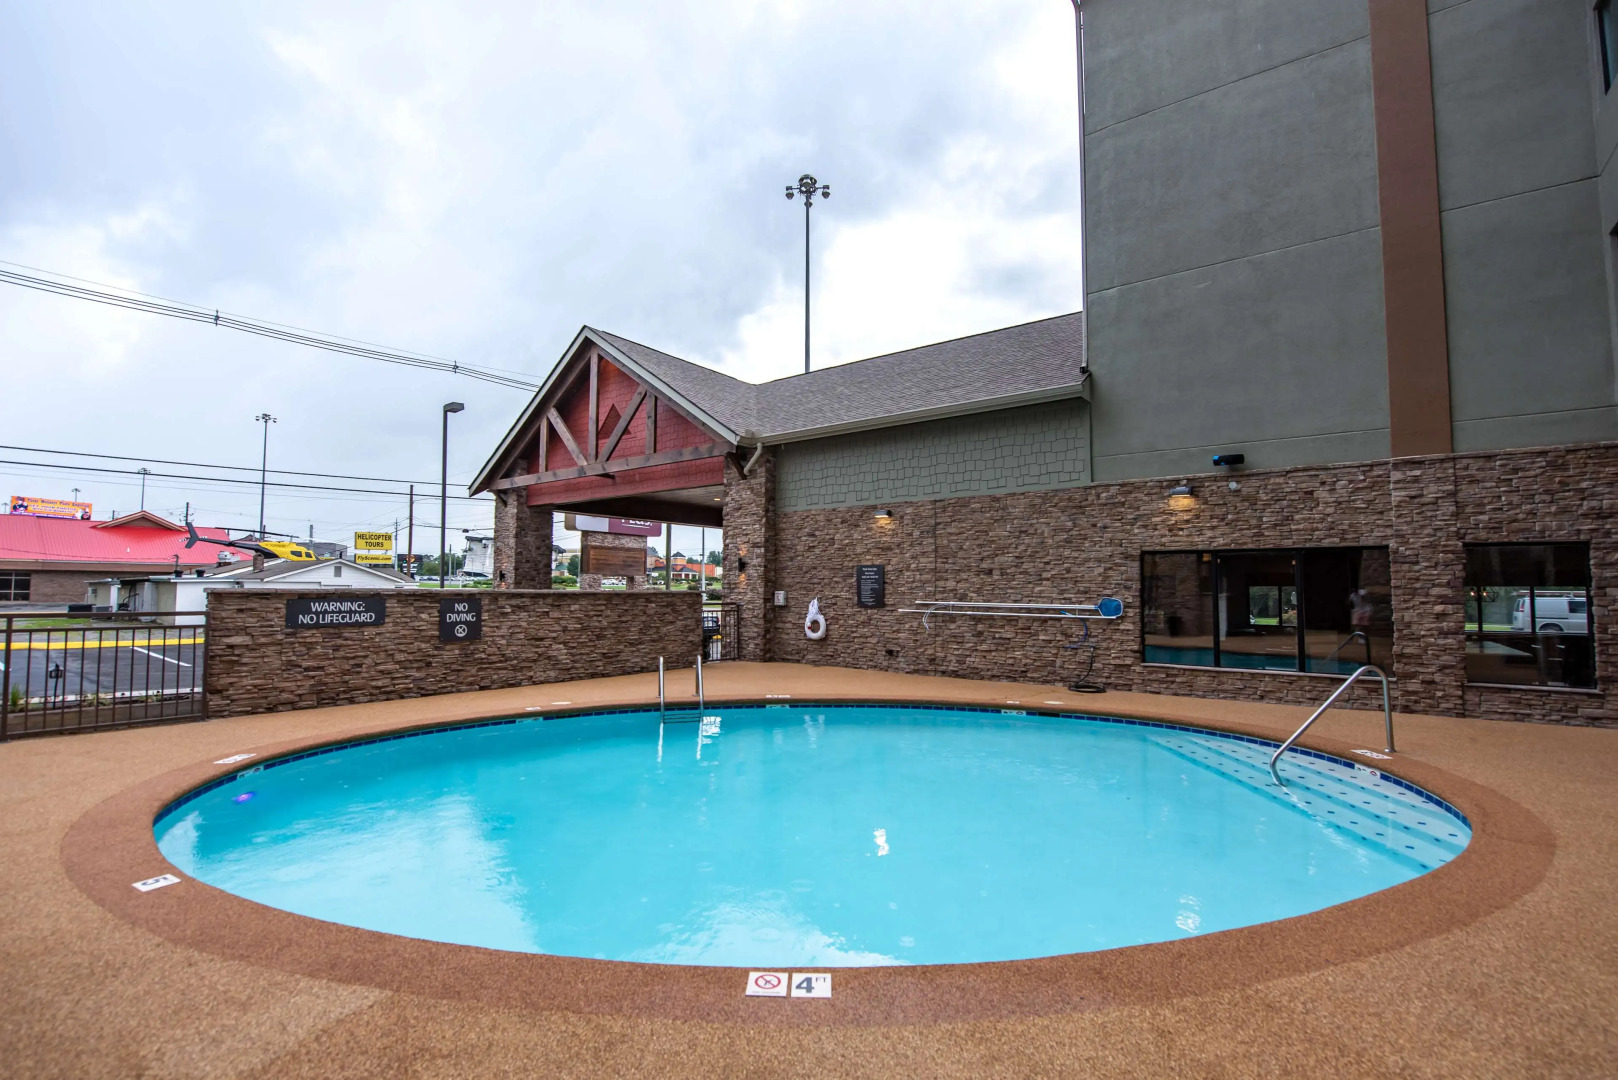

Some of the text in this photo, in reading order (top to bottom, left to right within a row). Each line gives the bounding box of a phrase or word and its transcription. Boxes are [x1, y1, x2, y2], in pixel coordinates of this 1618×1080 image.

[311, 602, 365, 611] WARNING:
[455, 603, 468, 611] NO
[298, 613, 375, 624] NO LIFEGUARD
[446, 613, 476, 622] DIVING
[796, 977, 815, 993] 4
